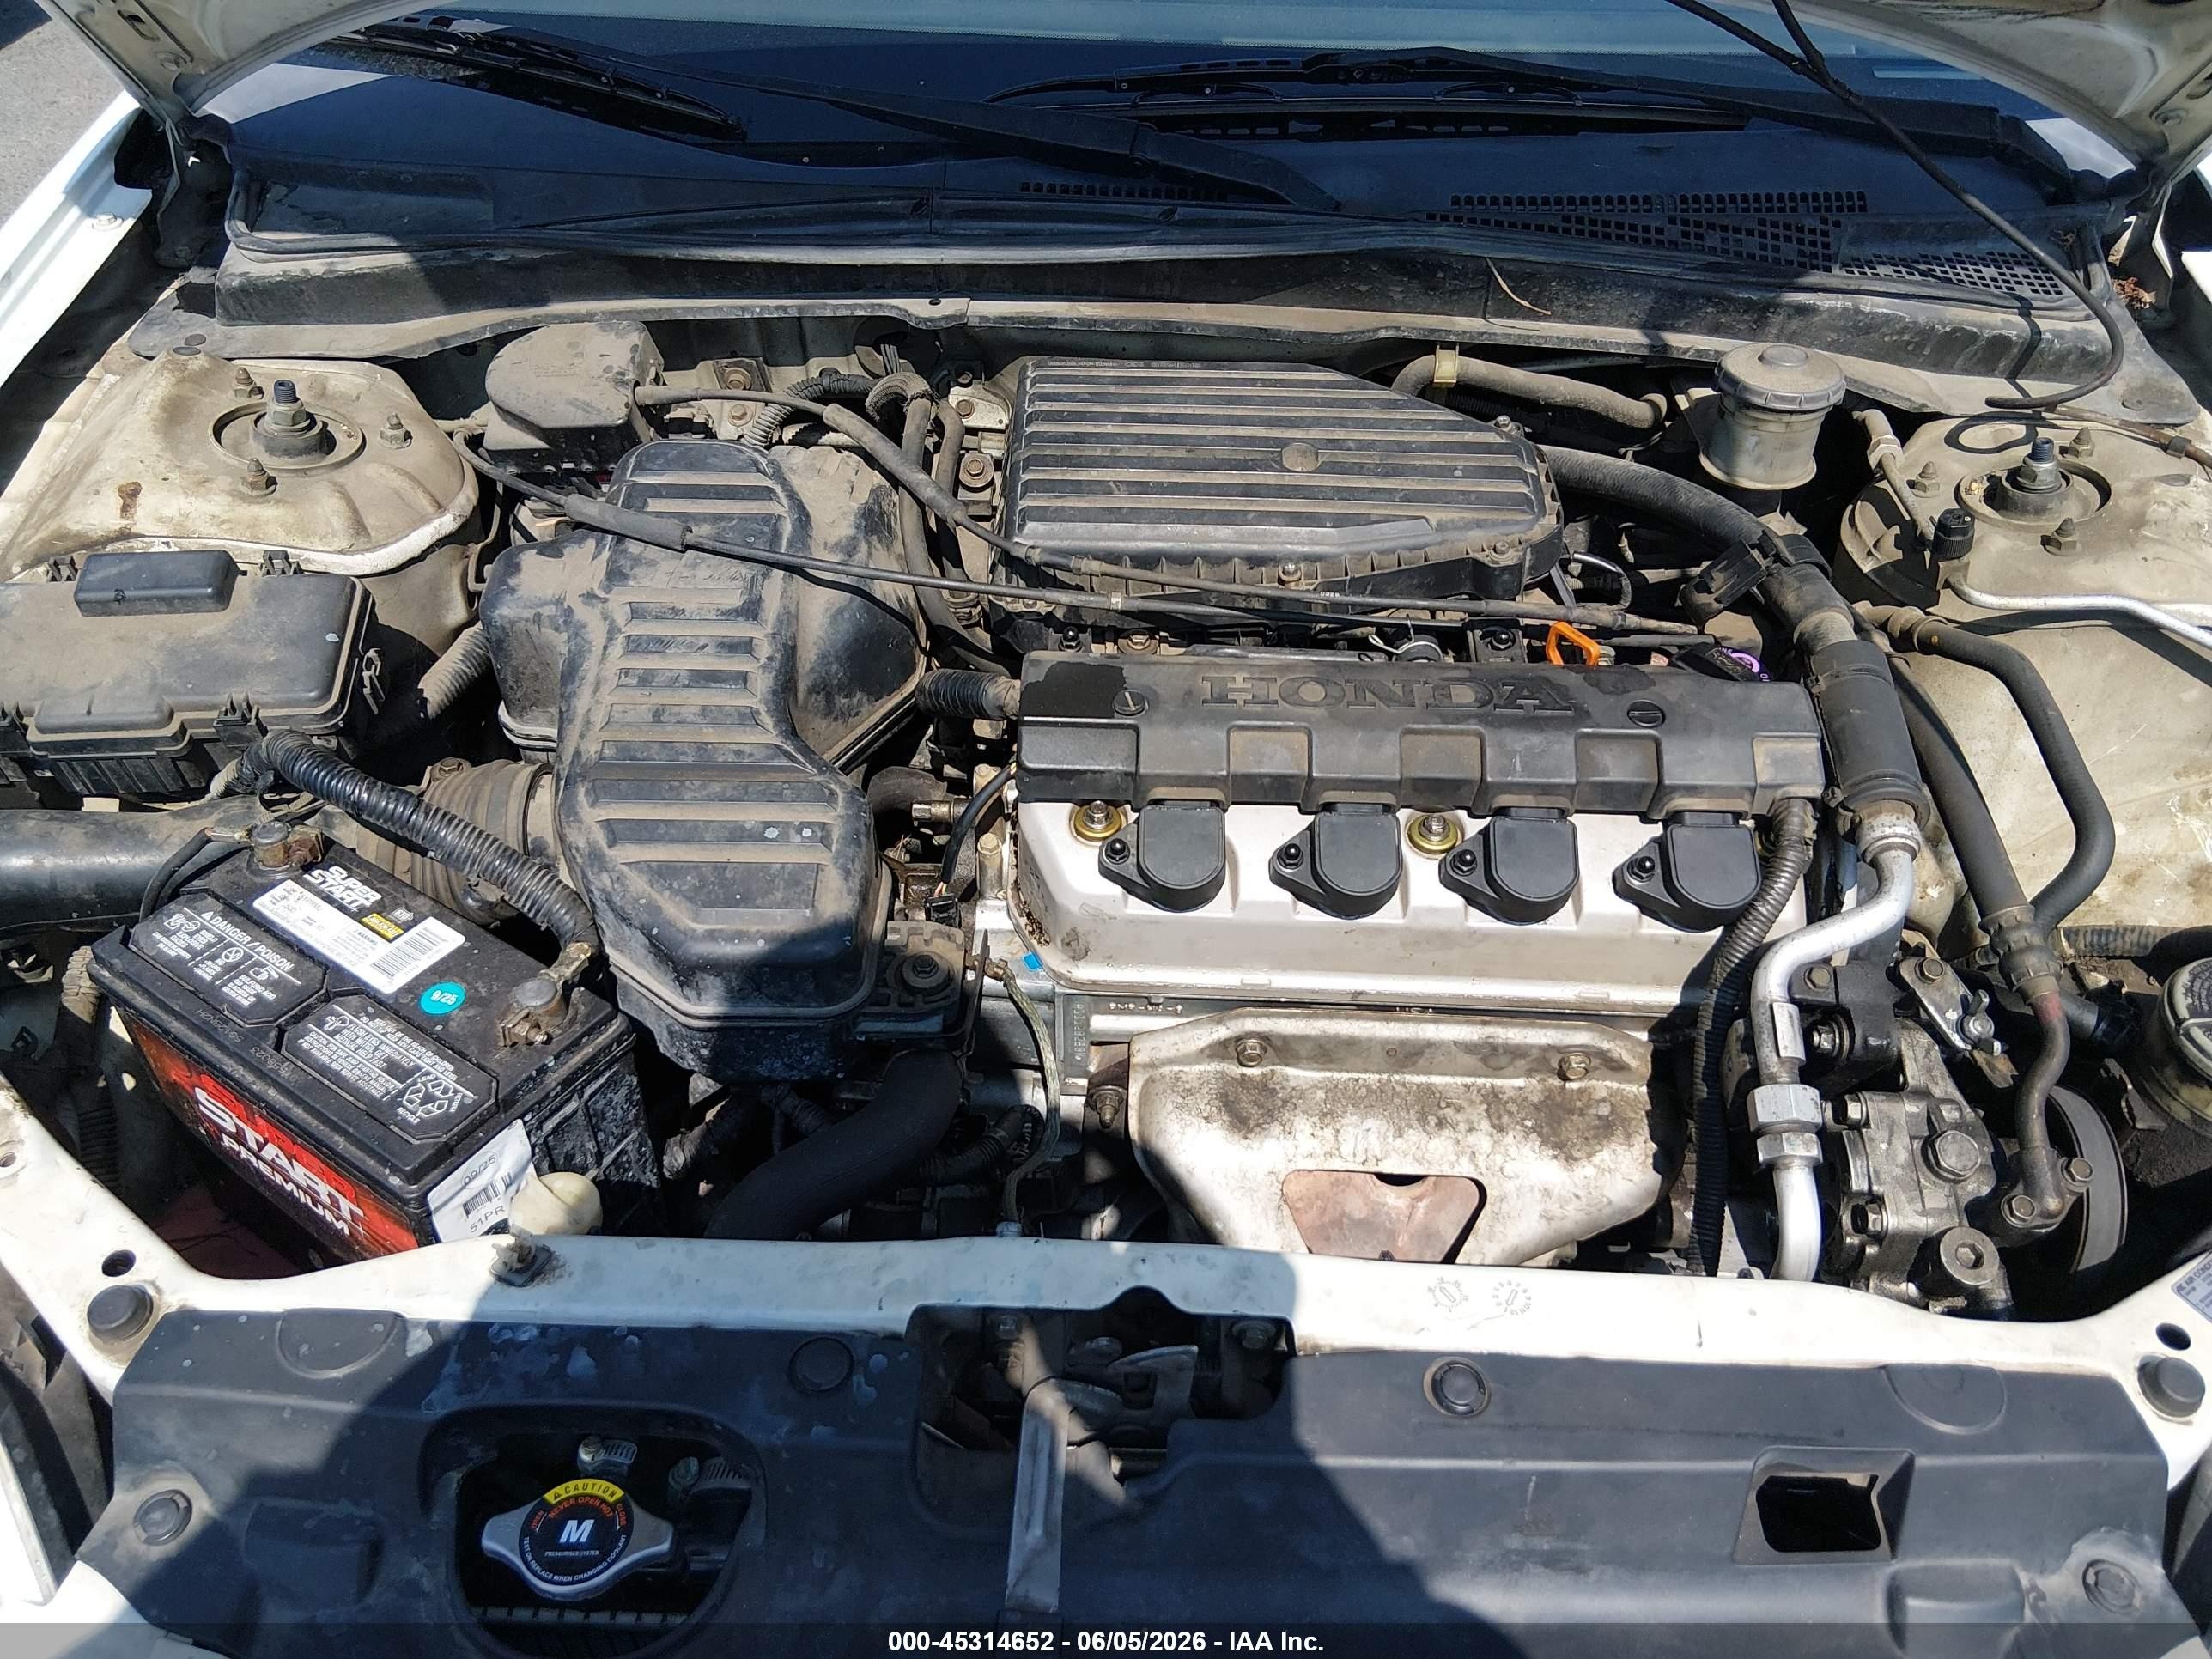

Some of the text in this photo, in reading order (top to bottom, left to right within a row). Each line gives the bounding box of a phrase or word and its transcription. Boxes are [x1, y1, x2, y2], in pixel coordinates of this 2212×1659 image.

[1202, 675, 1575, 714] HONDA
[303, 869, 372, 908] START
[328, 866, 382, 902] SUPER
[209, 915, 252, 944] DANGER
[252, 944, 296, 972] POISON
[430, 989, 459, 1006] 9/25
[332, 1032, 360, 1051] MEDICAL
[355, 1047, 374, 1060] HELP
[340, 1028, 358, 1041] WITH
[373, 1048, 389, 1060] GET
[346, 1022, 416, 1068] FLUSH EYES IMMEDIATELY
[417, 1073, 436, 1083] LEAD
[397, 1106, 421, 1125] RECYCLE
[449, 1092, 463, 1113] RETURN
[194, 1086, 365, 1220] START
[222, 1132, 350, 1237] PREMIUM
[464, 1154, 496, 1186] 09/25
[470, 1205, 506, 1233] 51PR
[564, 1482, 618, 1498] CAUTION
[549, 1496, 614, 1518] NEVER OPEN HOT
[559, 1519, 595, 1543] M
[526, 1552, 533, 1560] OR
[530, 1559, 552, 1579] REPLACE
[574, 1561, 607, 1581] CHANGING
[606, 1534, 627, 1563] COOLANT
